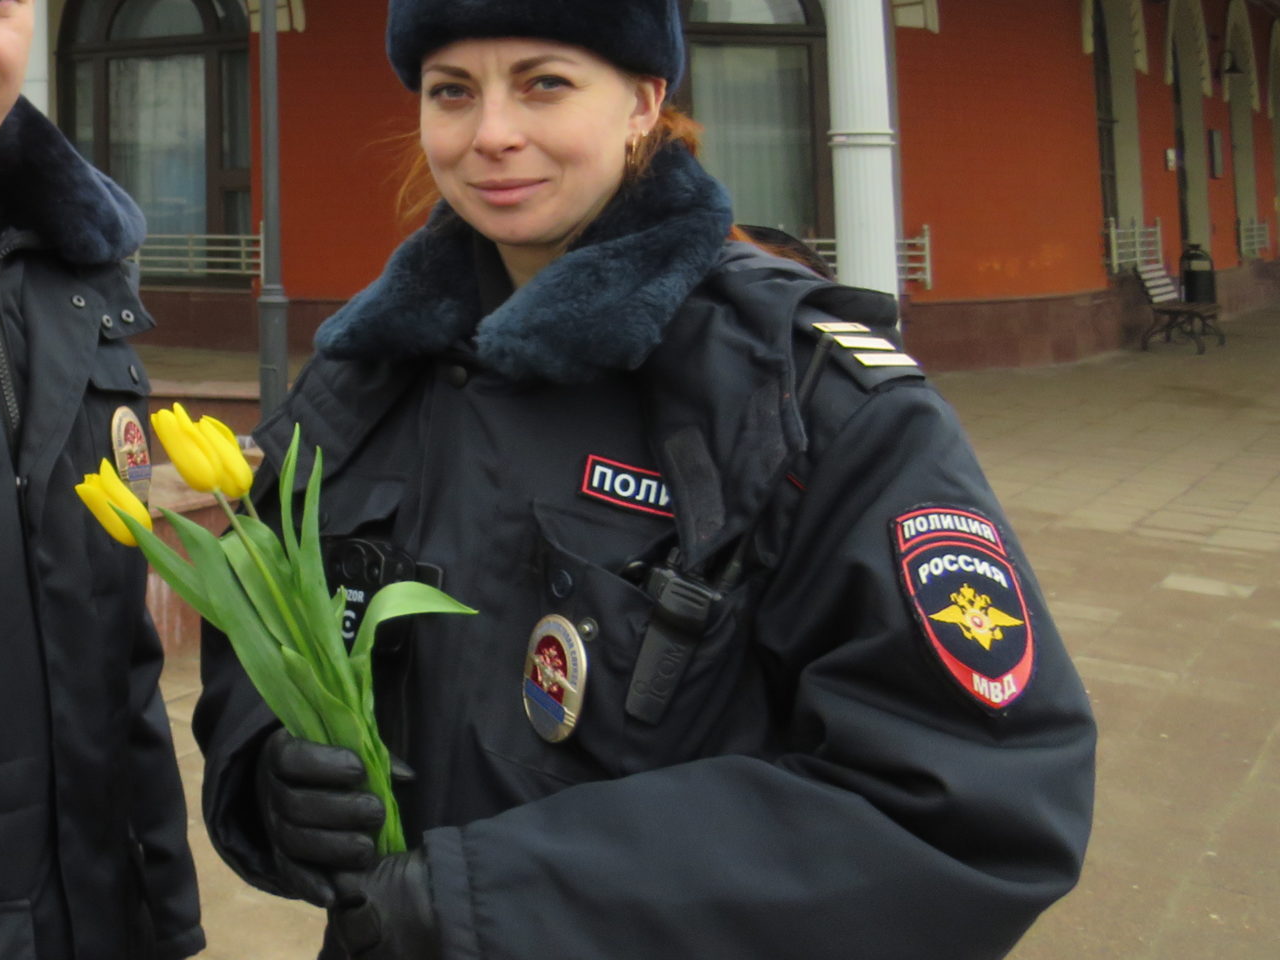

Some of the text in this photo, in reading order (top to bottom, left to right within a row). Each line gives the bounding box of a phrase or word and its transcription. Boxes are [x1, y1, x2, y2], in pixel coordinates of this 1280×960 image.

[902, 514, 996, 543] ПОЛИЦИЯ
[918, 554, 1008, 589] РОССИЯ
[336, 587, 365, 603] ZOR
[972, 672, 1017, 704] МВД
